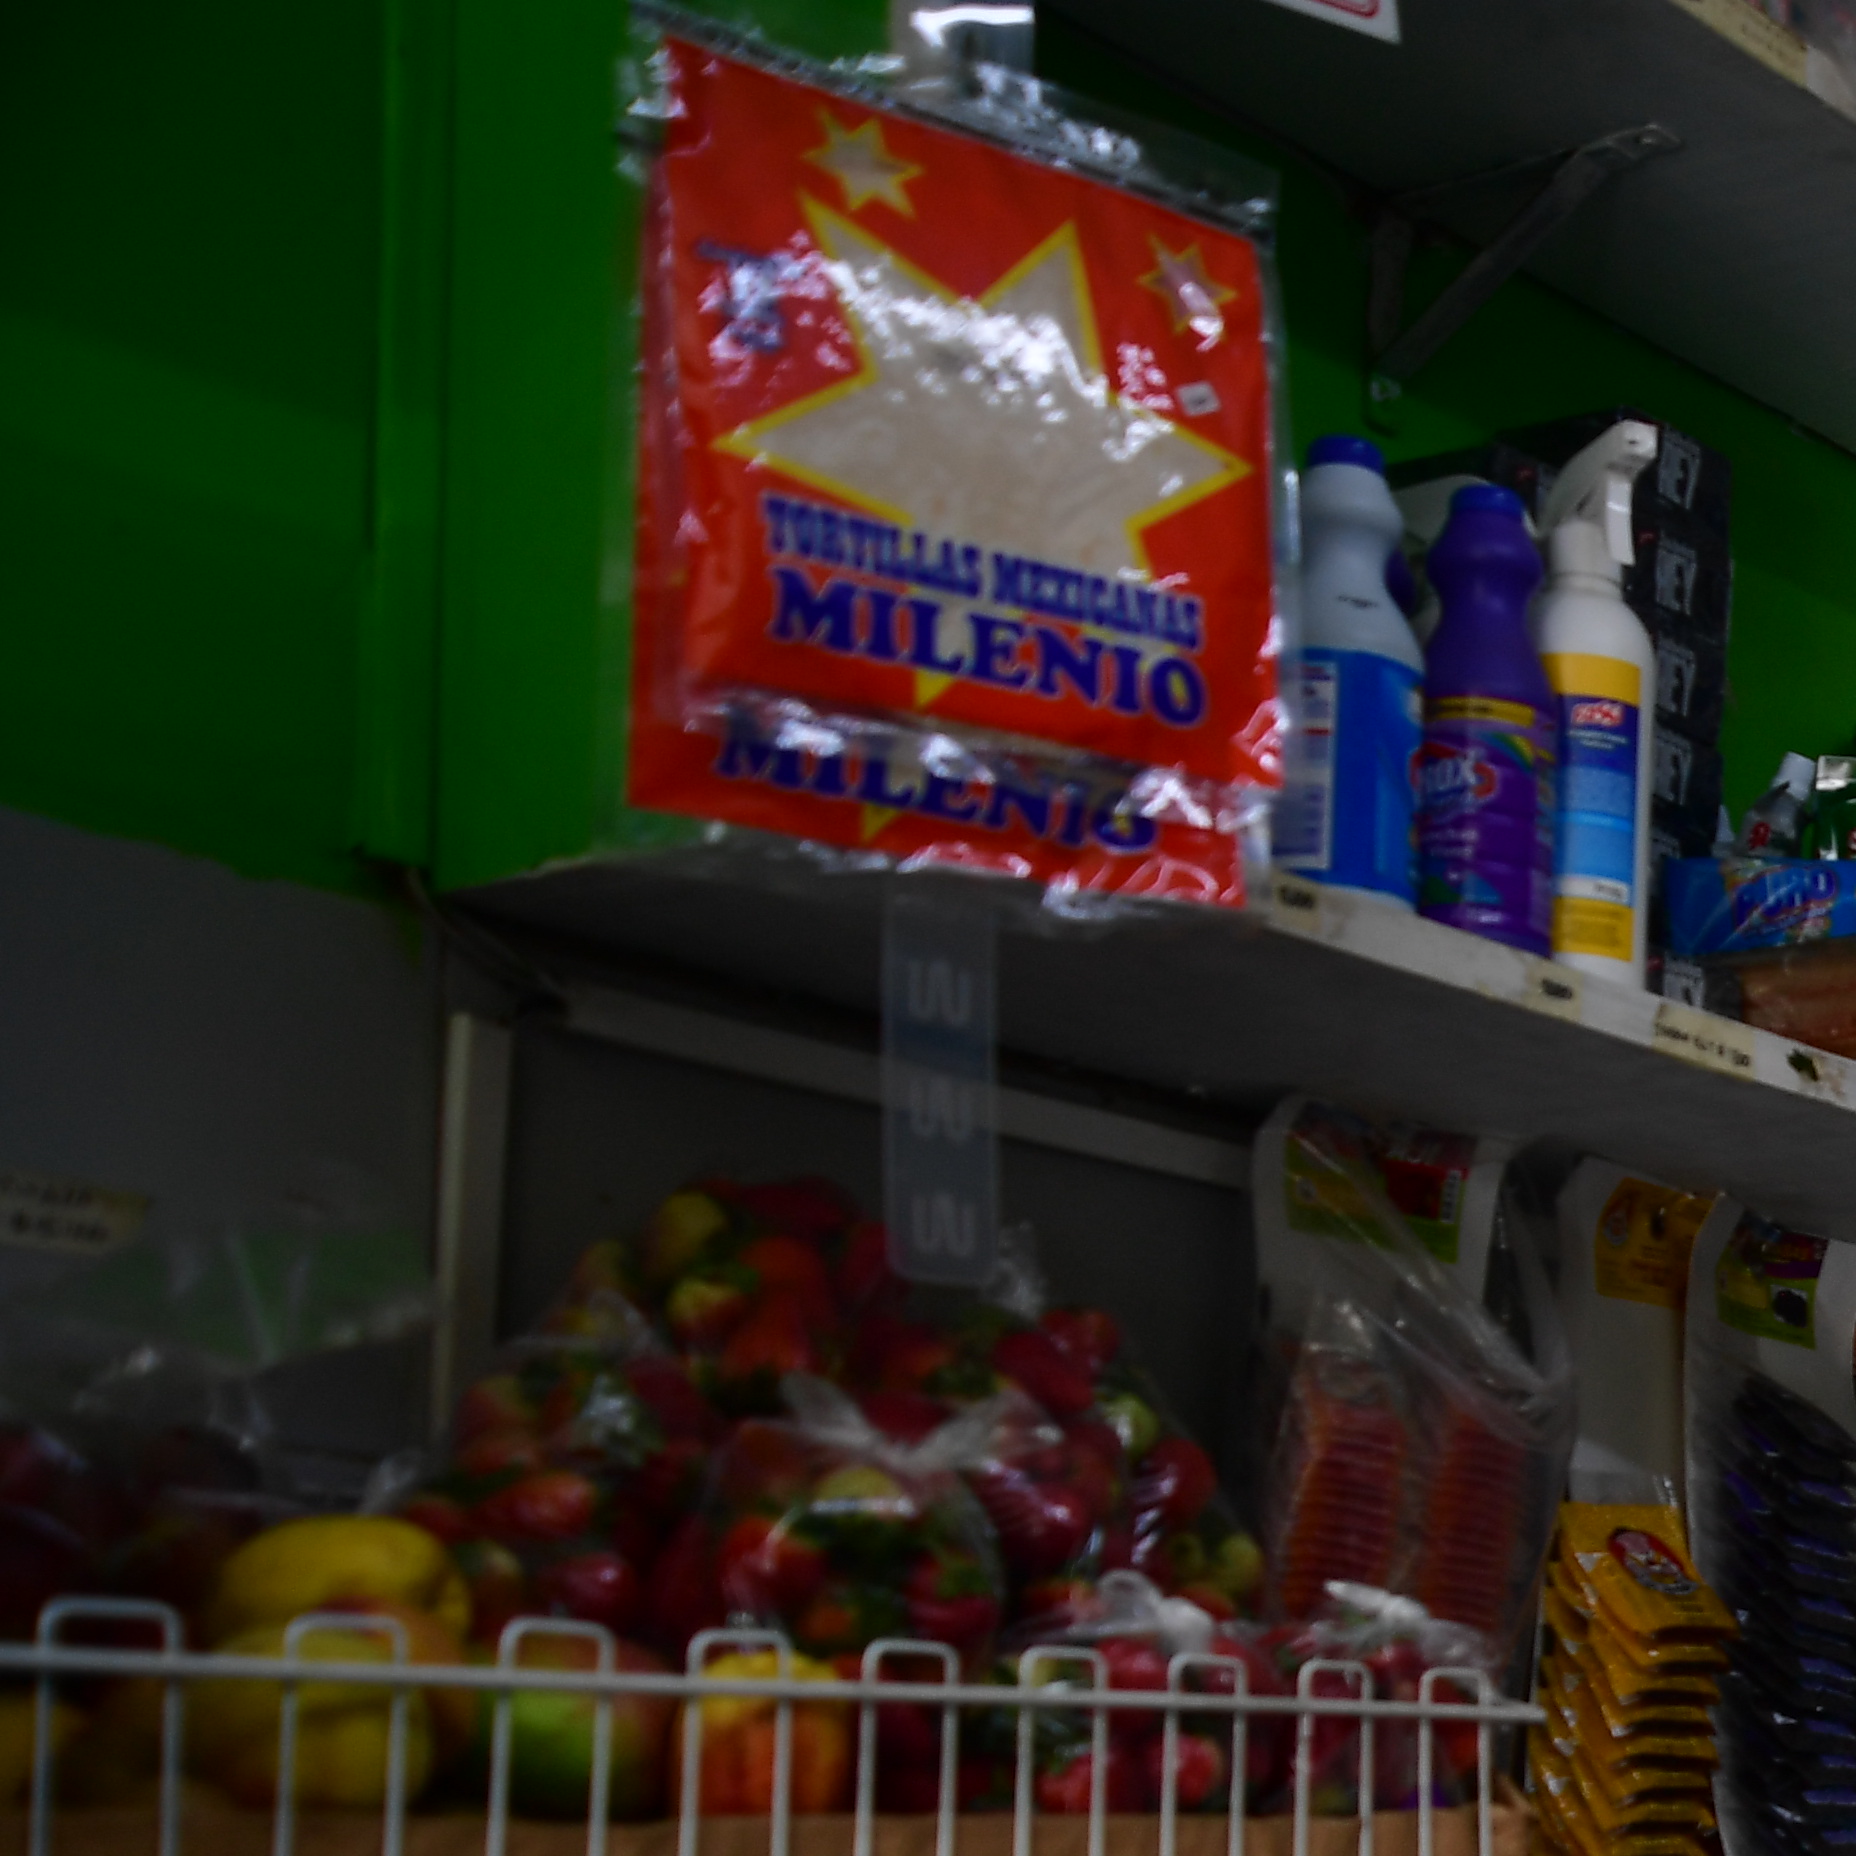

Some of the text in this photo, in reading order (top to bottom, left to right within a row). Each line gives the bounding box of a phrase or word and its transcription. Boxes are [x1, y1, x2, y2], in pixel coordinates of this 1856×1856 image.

[762, 492, 1203, 651] TORTILLAS MEXICANAS
[769, 563, 1205, 728] MILENIO
